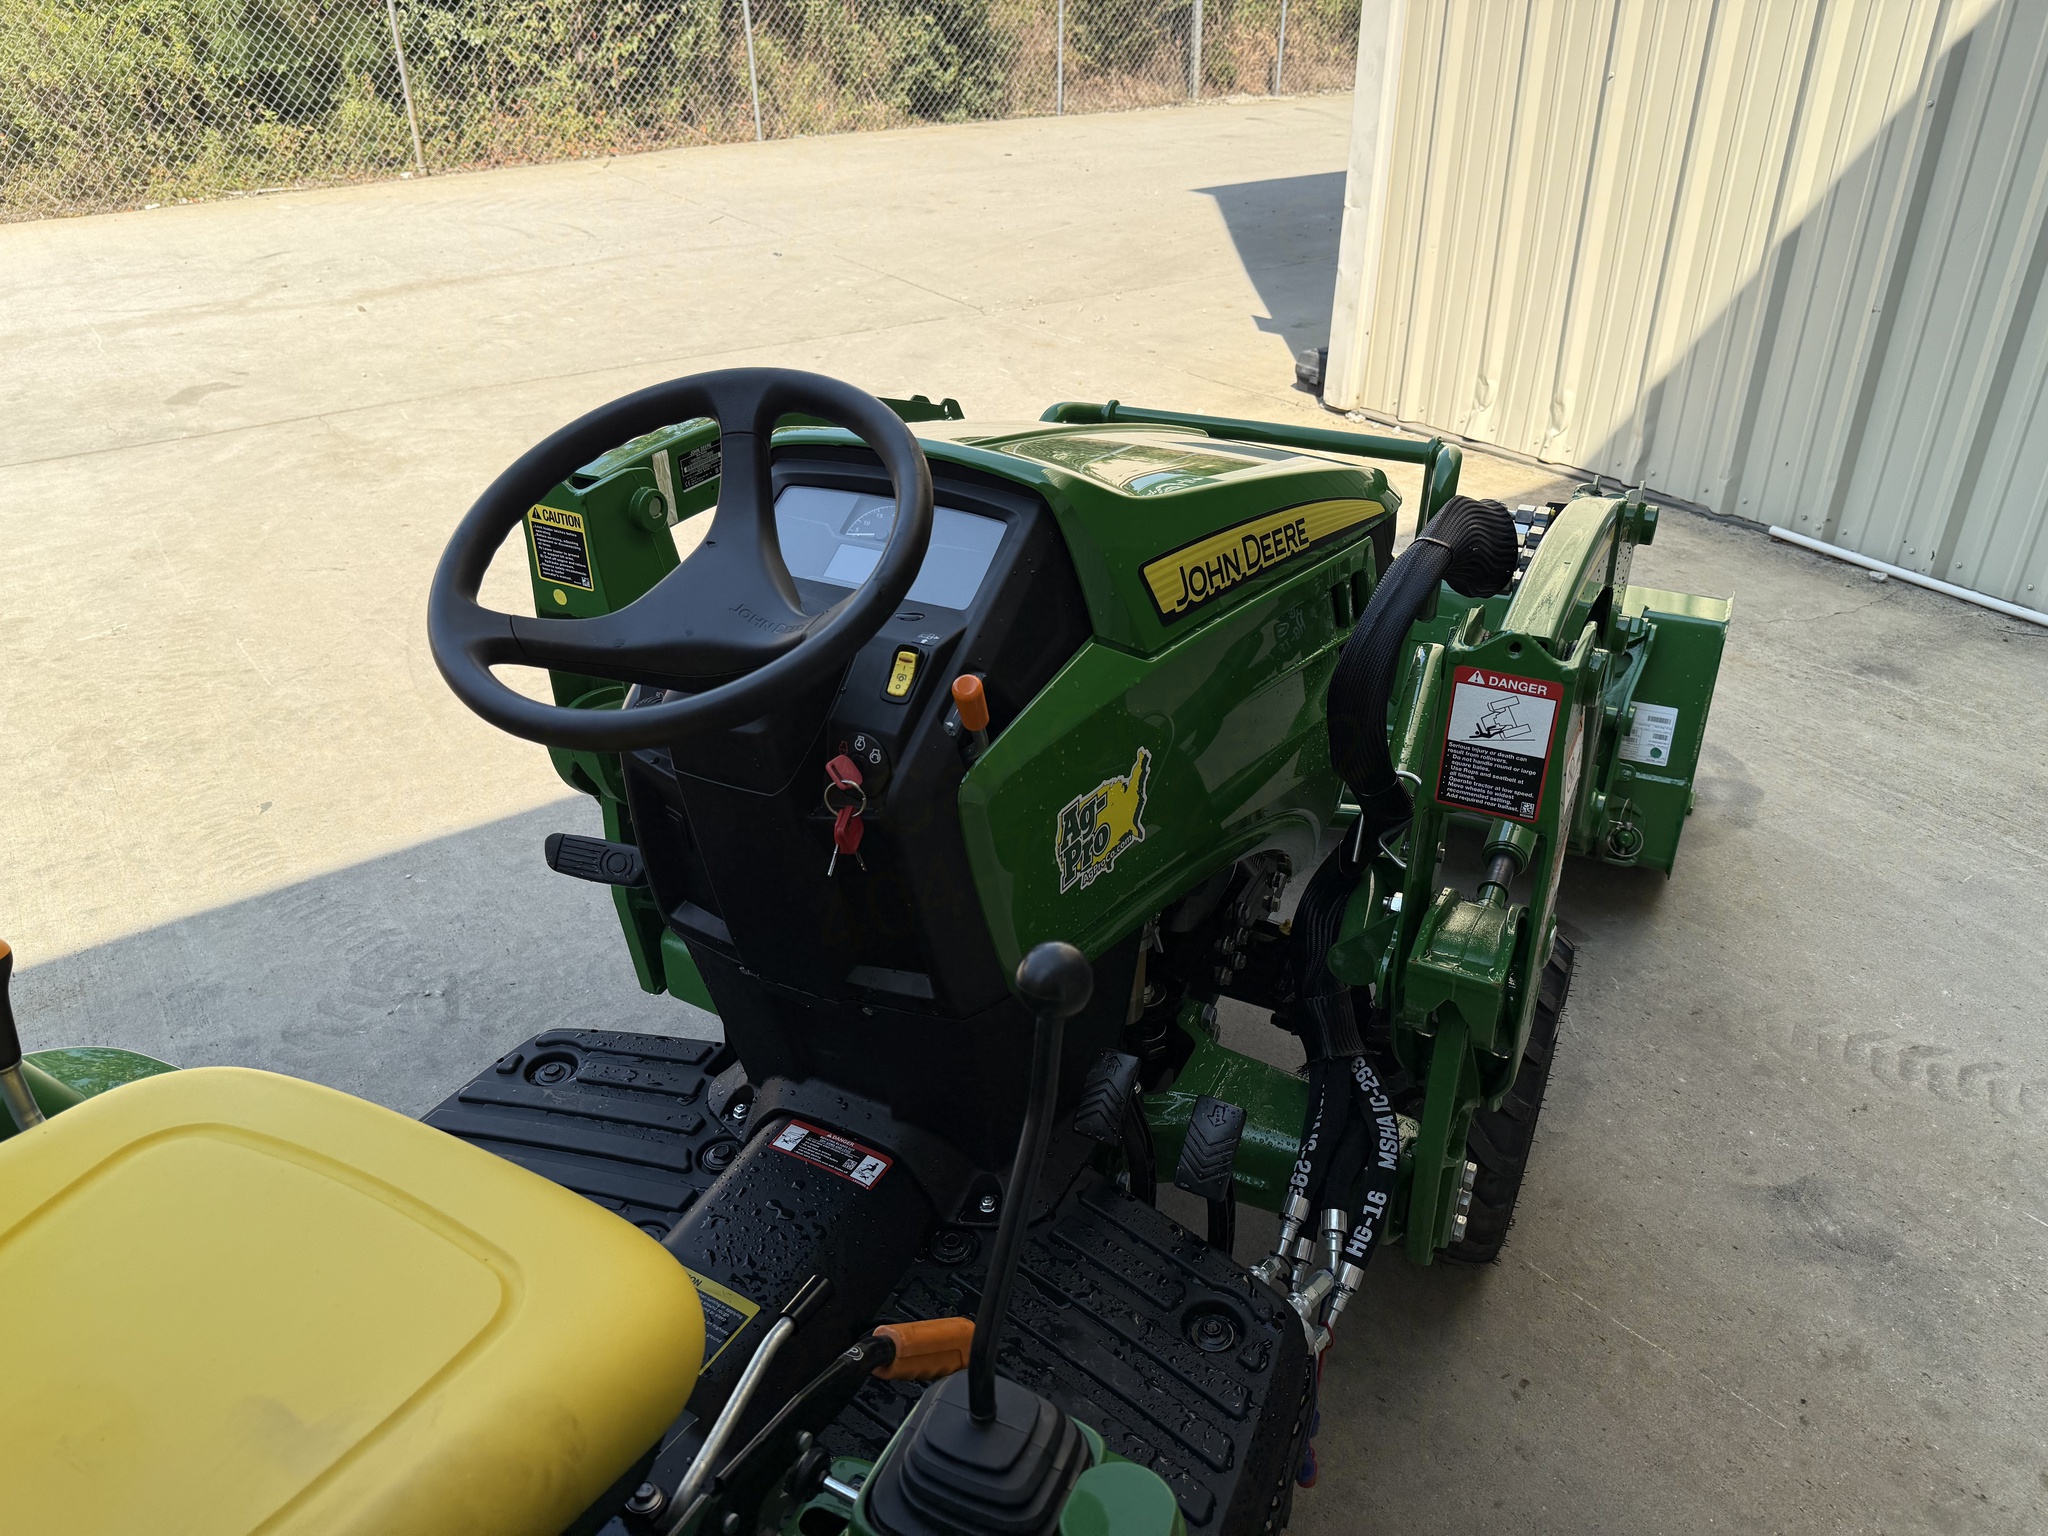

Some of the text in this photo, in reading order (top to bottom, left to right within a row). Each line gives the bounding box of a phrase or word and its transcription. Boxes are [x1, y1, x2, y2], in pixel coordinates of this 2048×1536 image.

[542, 509, 581, 528] CAUTION
[1176, 517, 1310, 608] JOHN DEERE
[728, 604, 775, 632] JOHN
[1488, 676, 1548, 696] DANGER
[1448, 742, 1470, 750] Serious
[1451, 760, 1471, 768] square
[1473, 758, 1493, 766] handle
[1448, 775, 1472, 785] Operate
[1473, 781, 1493, 790] tractor
[1463, 767, 1478, 775] Rops
[1492, 774, 1516, 783] seatbelt
[1465, 785, 1485, 793] wheels
[1494, 792, 1513, 800] widest
[1061, 791, 1108, 850] Ag-
[1060, 822, 1110, 890] Pro
[1082, 834, 1132, 886] AgProCo.com
[833, 1136, 854, 1146] DANGER
[1346, 1056, 1398, 1258] HG-16 MSHA IC-293
